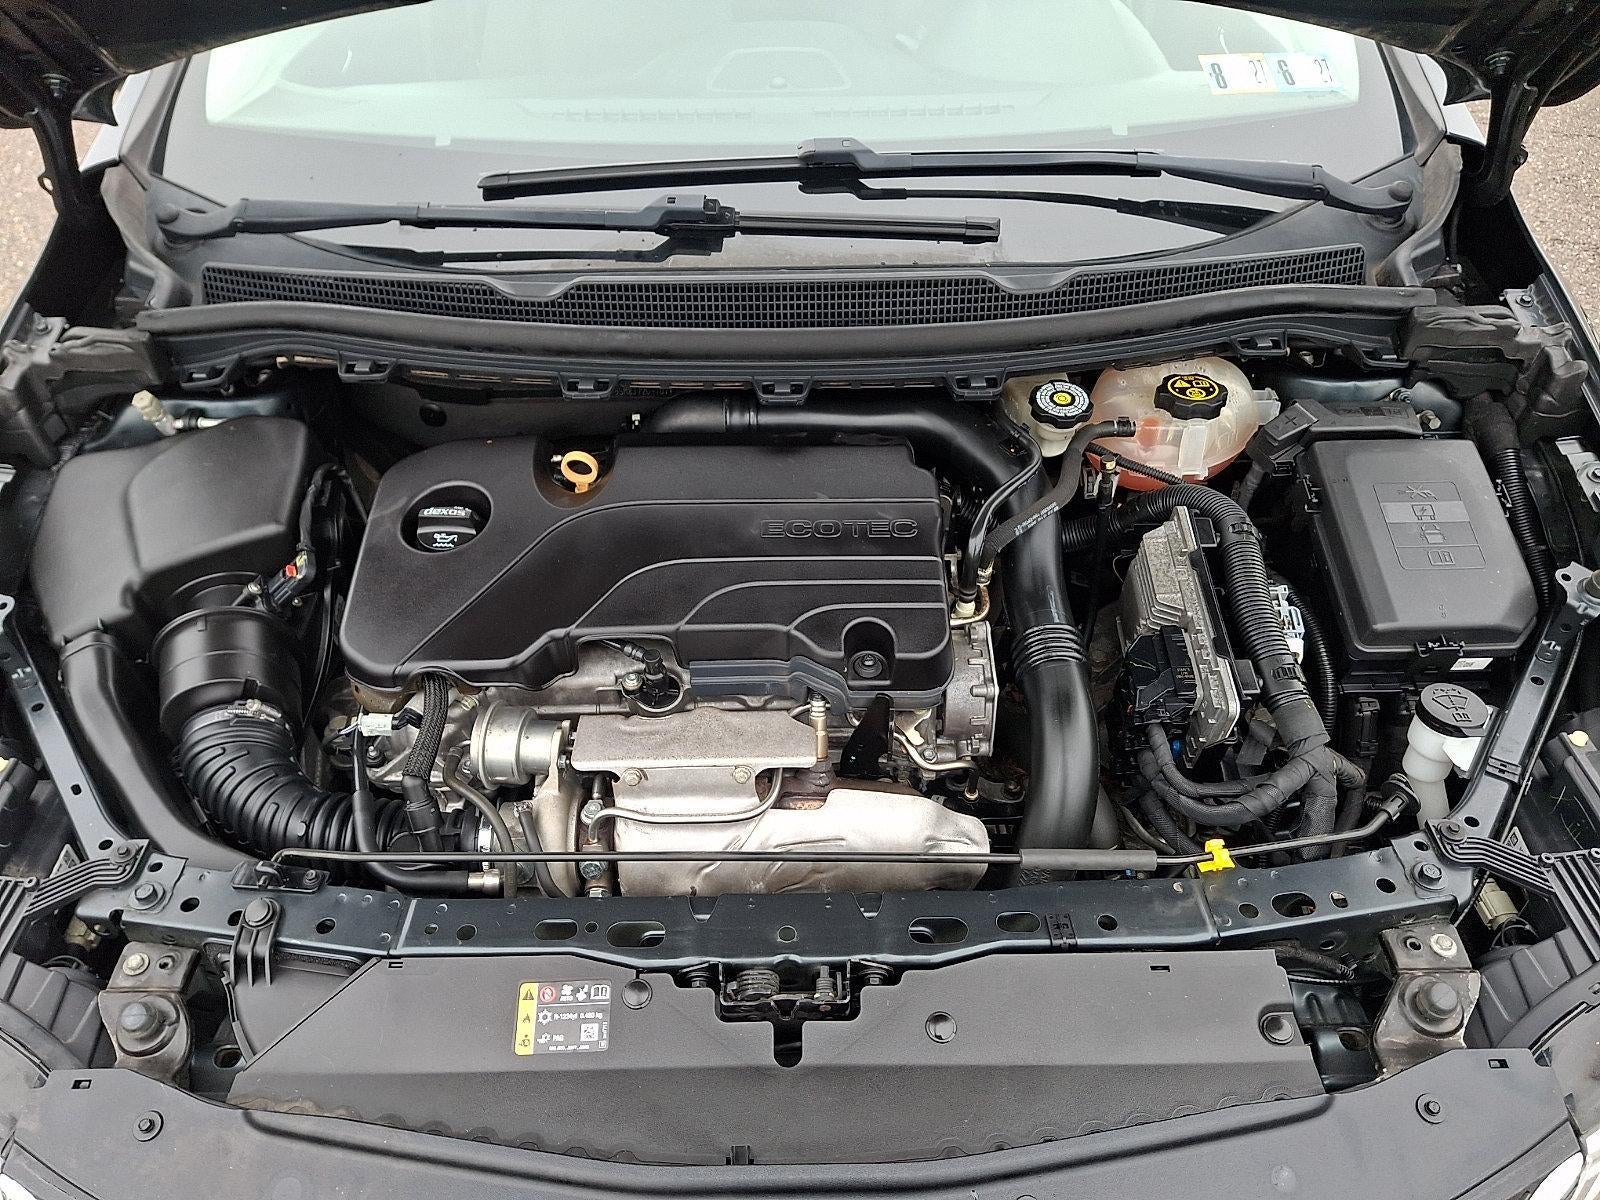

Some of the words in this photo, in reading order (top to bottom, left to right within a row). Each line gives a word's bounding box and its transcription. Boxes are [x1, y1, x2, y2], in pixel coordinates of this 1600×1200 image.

[1210, 62, 1228, 89] 8
[1277, 59, 1296, 86] 6
[423, 506, 466, 516] dexos
[760, 518, 918, 539] ECOTEC
